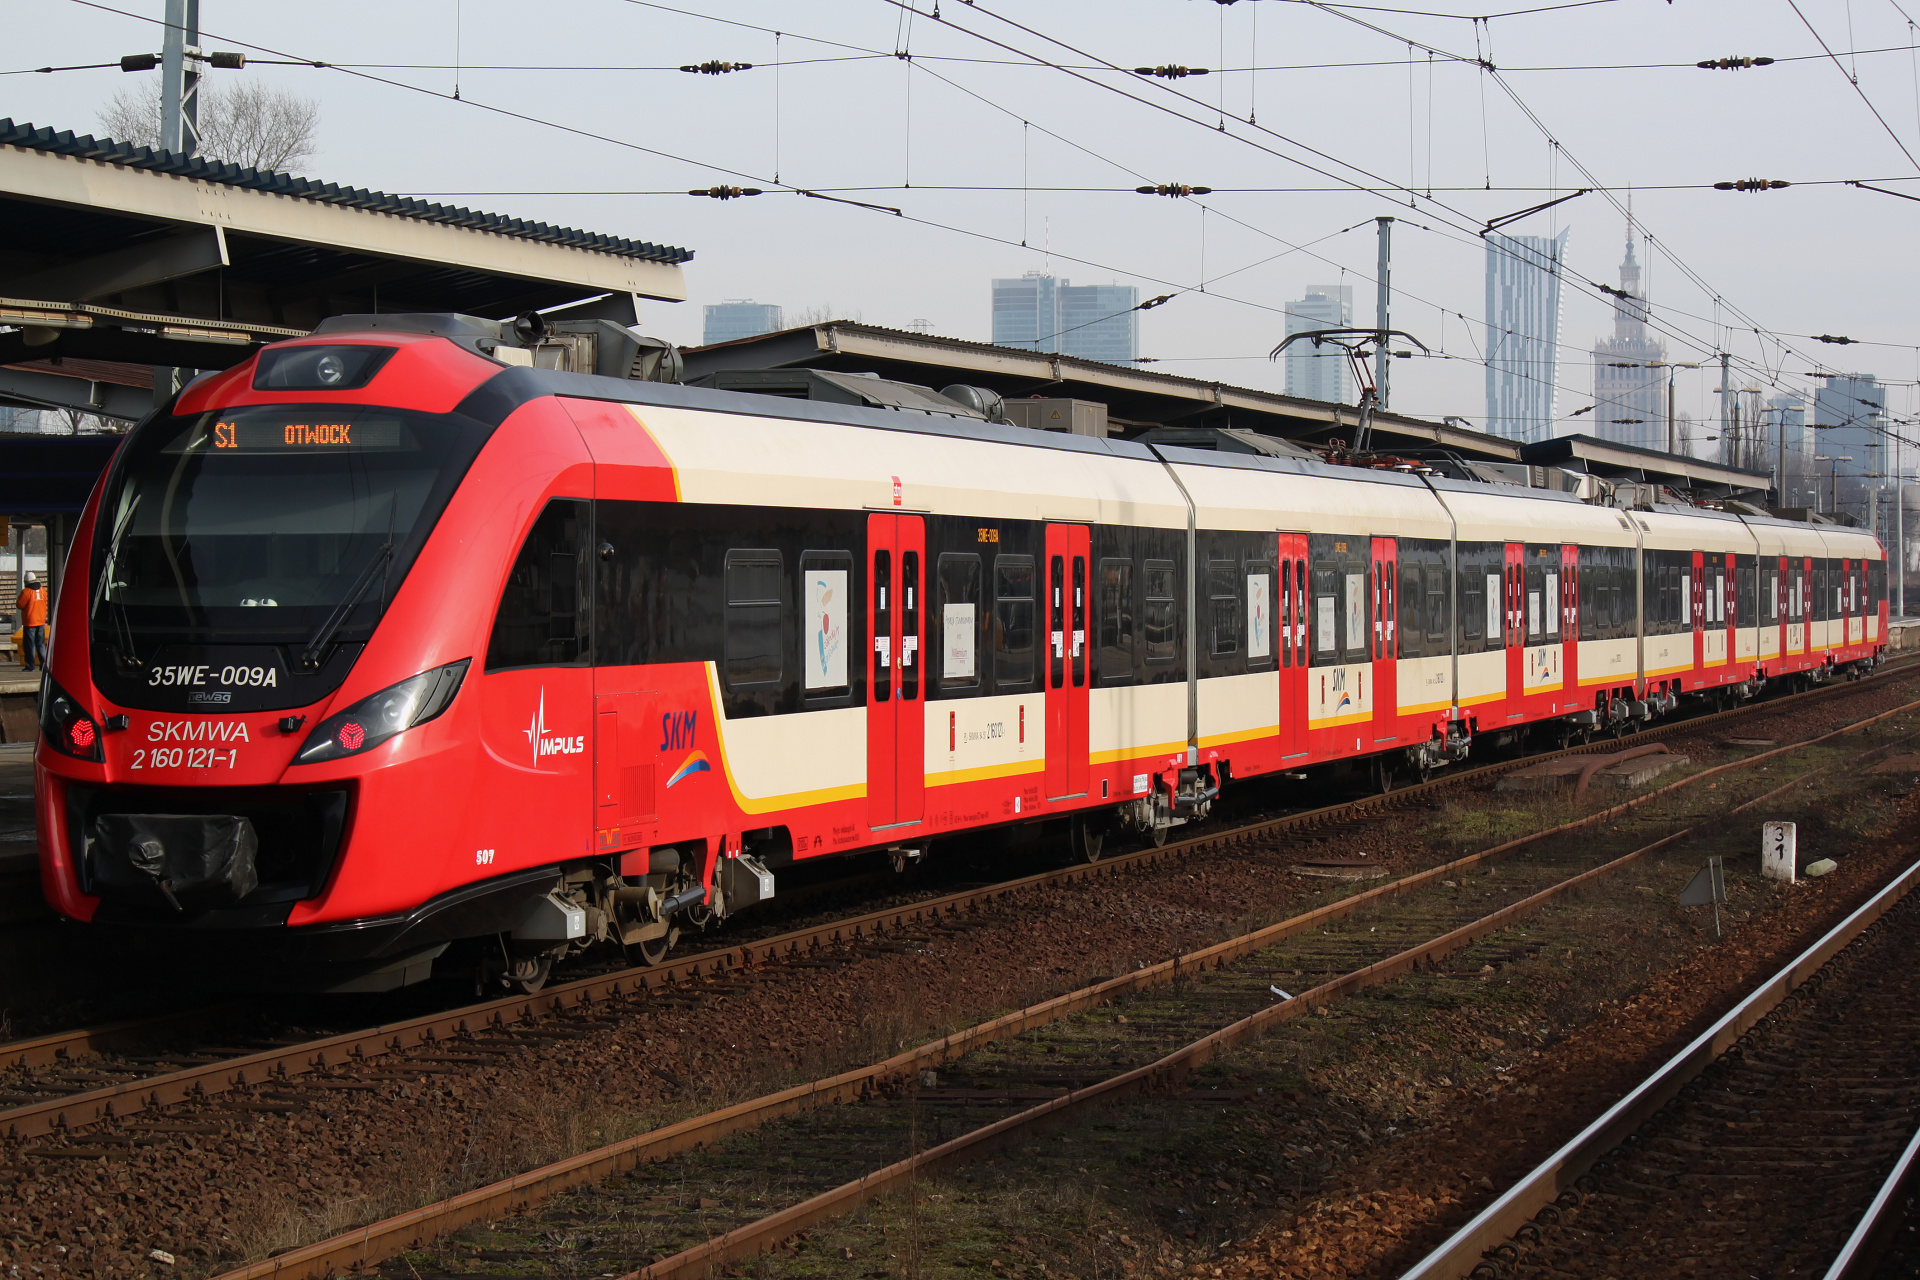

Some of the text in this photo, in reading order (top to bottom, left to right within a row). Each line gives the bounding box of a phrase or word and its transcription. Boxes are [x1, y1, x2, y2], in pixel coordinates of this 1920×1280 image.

[215, 422, 351, 448] S1 OTWOCK
[148, 665, 277, 688] 35WE-009A
[1333, 668, 1346, 692] SKM
[147, 721, 250, 743] SKMWA
[660, 710, 697, 751] SKM
[539, 735, 584, 756] IMPULS
[1775, 826, 1784, 842] 3
[476, 849, 495, 866] 507
[1775, 843, 1784, 860] 1
